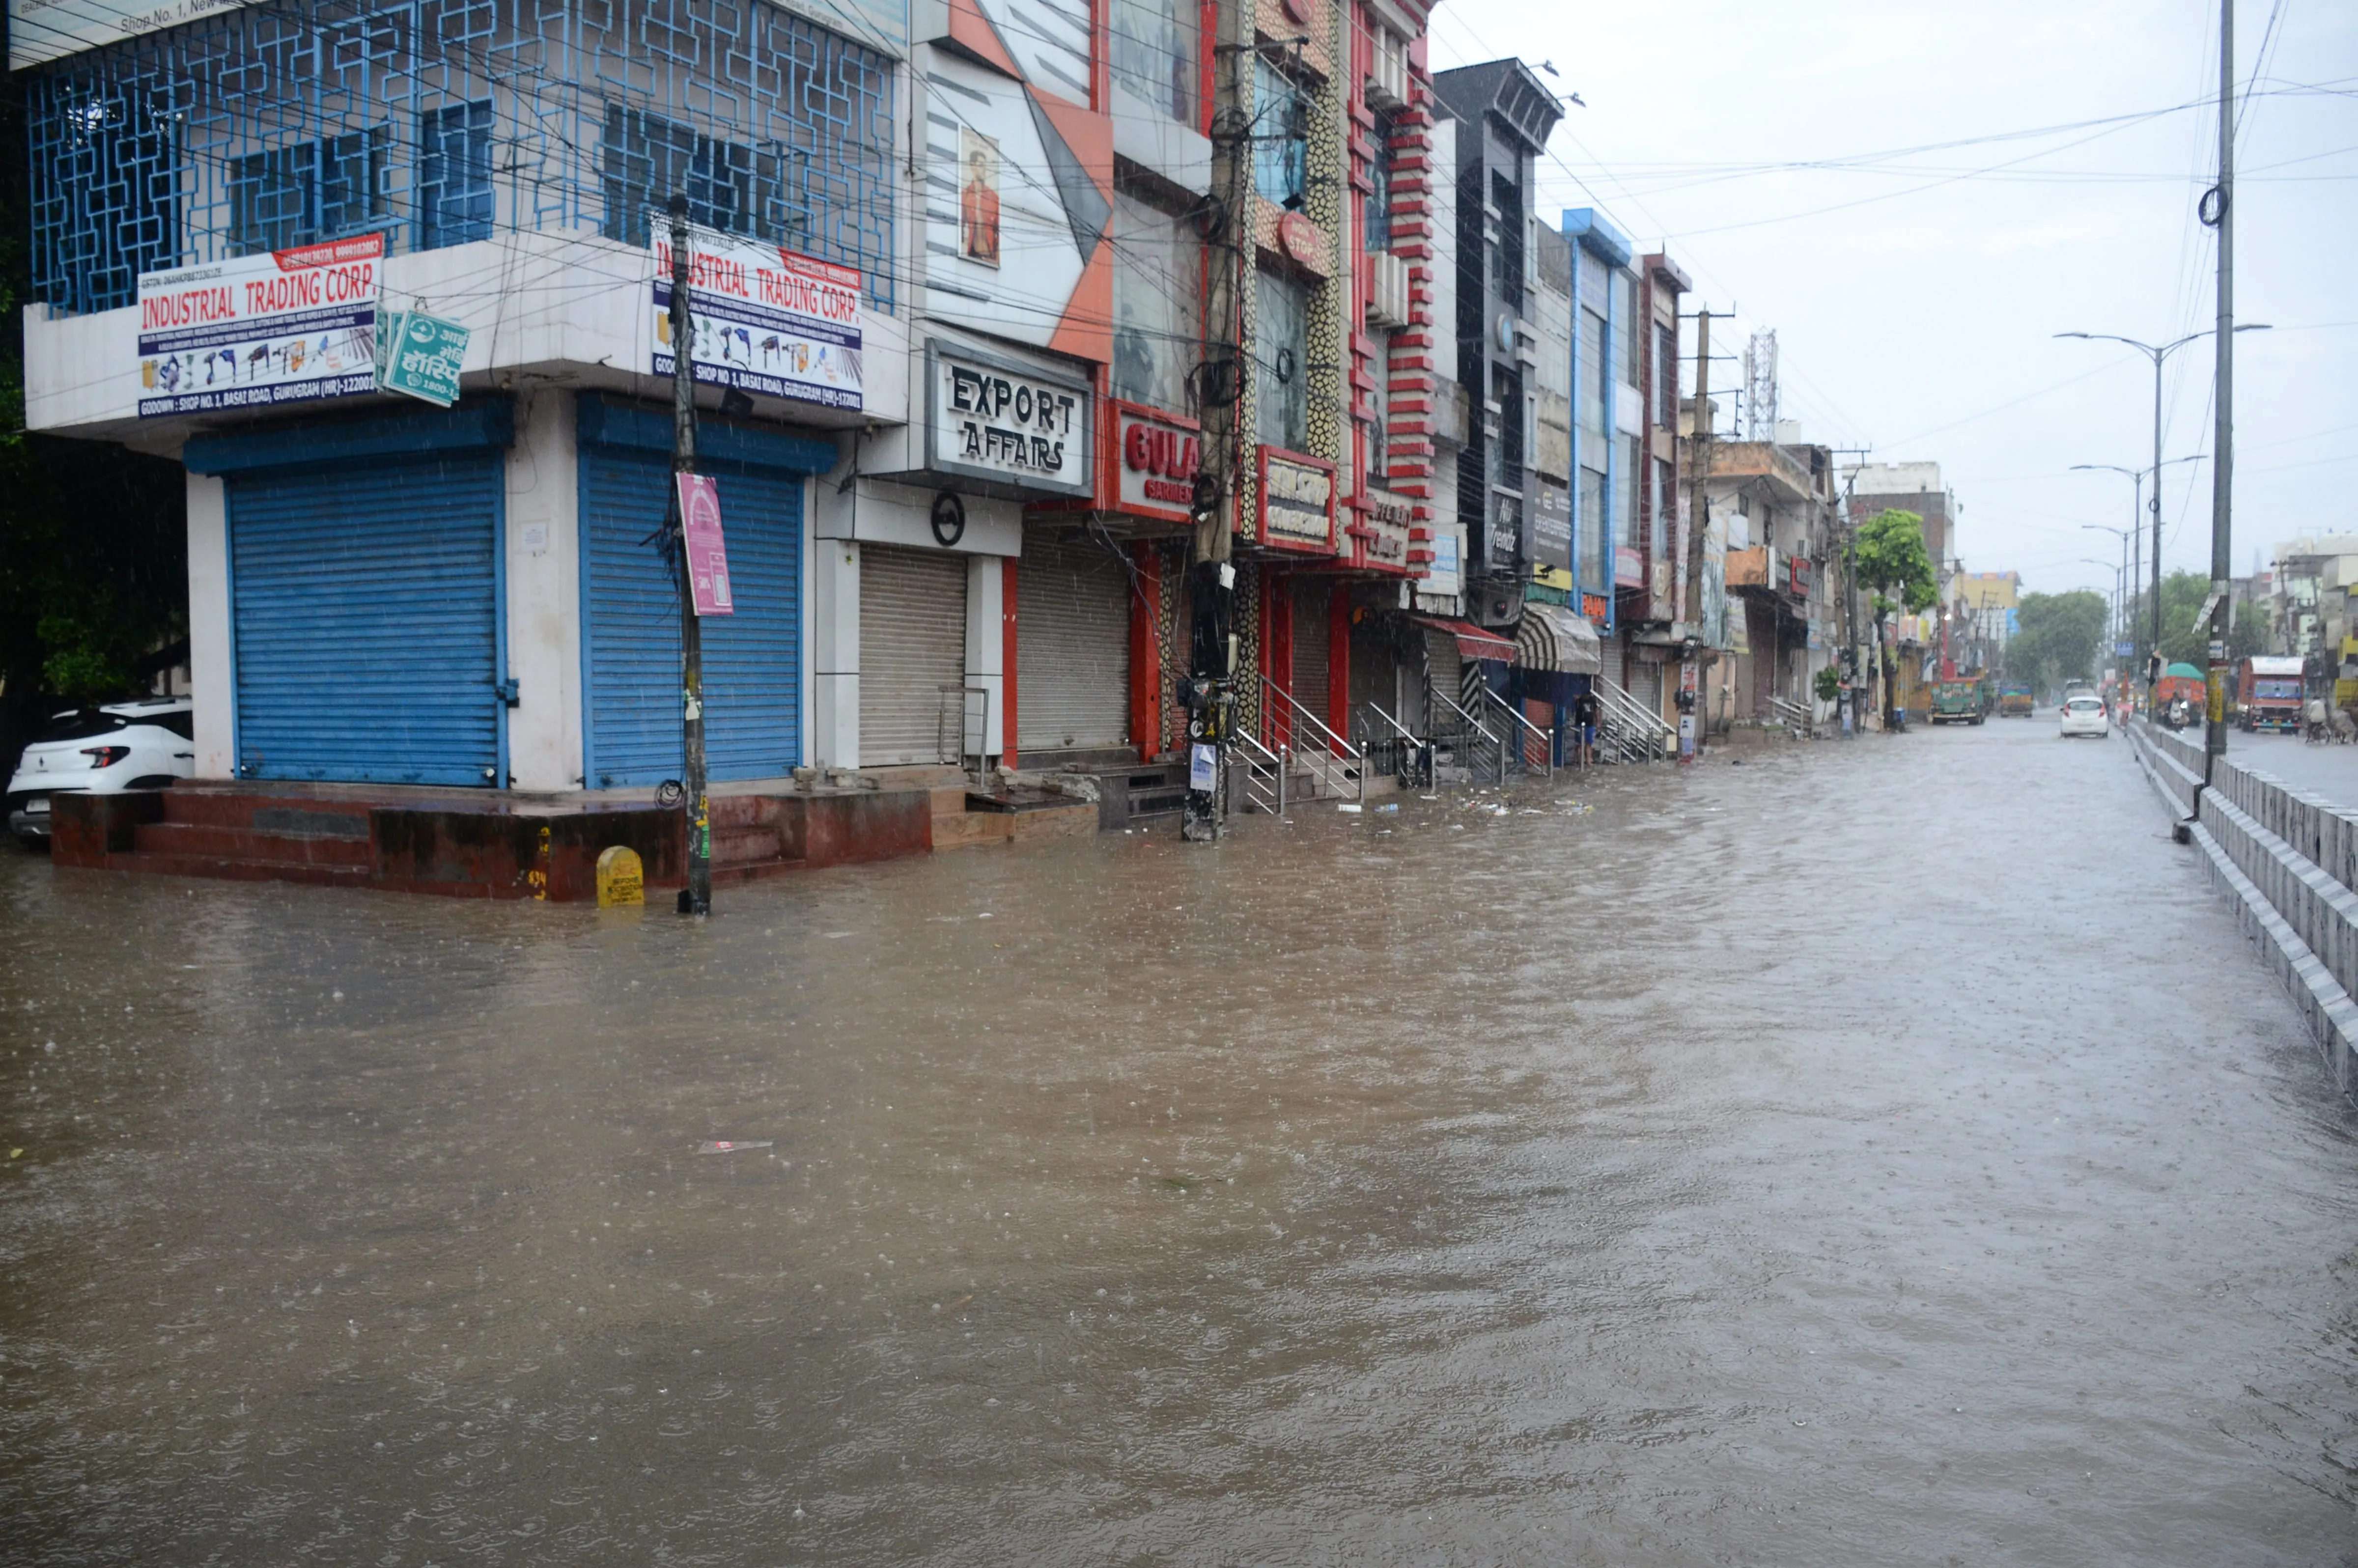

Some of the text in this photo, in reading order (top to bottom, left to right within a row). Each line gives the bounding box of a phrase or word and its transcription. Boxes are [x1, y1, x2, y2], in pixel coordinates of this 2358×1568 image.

[121, 15, 150, 31] Shop
[154, 8, 172, 22] No.
[142, 285, 235, 330] INDUSTRIAL
[245, 271, 321, 314] TRADING
[326, 263, 376, 303] CORP.
[657, 241, 749, 297] INUSTRIAL
[757, 268, 817, 314] TRADING
[822, 285, 859, 324] CORP.
[141, 399, 174, 415] GODOWN
[179, 395, 199, 411] SHOP
[200, 394, 213, 408] NO.
[224, 391, 247, 406] BASAI
[273, 381, 320, 400] GURUGRAM
[423, 379, 454, 397] 1800-1
[696, 364, 717, 382] SHOP
[739, 373, 761, 390] BASAI
[784, 381, 821, 401] GURUGRAM
[951, 365, 1074, 434] EXPORT
[963, 420, 1064, 471] AFFAIRS
[1125, 423, 1200, 482] GULA
[1144, 479, 1193, 504] GARMEN
